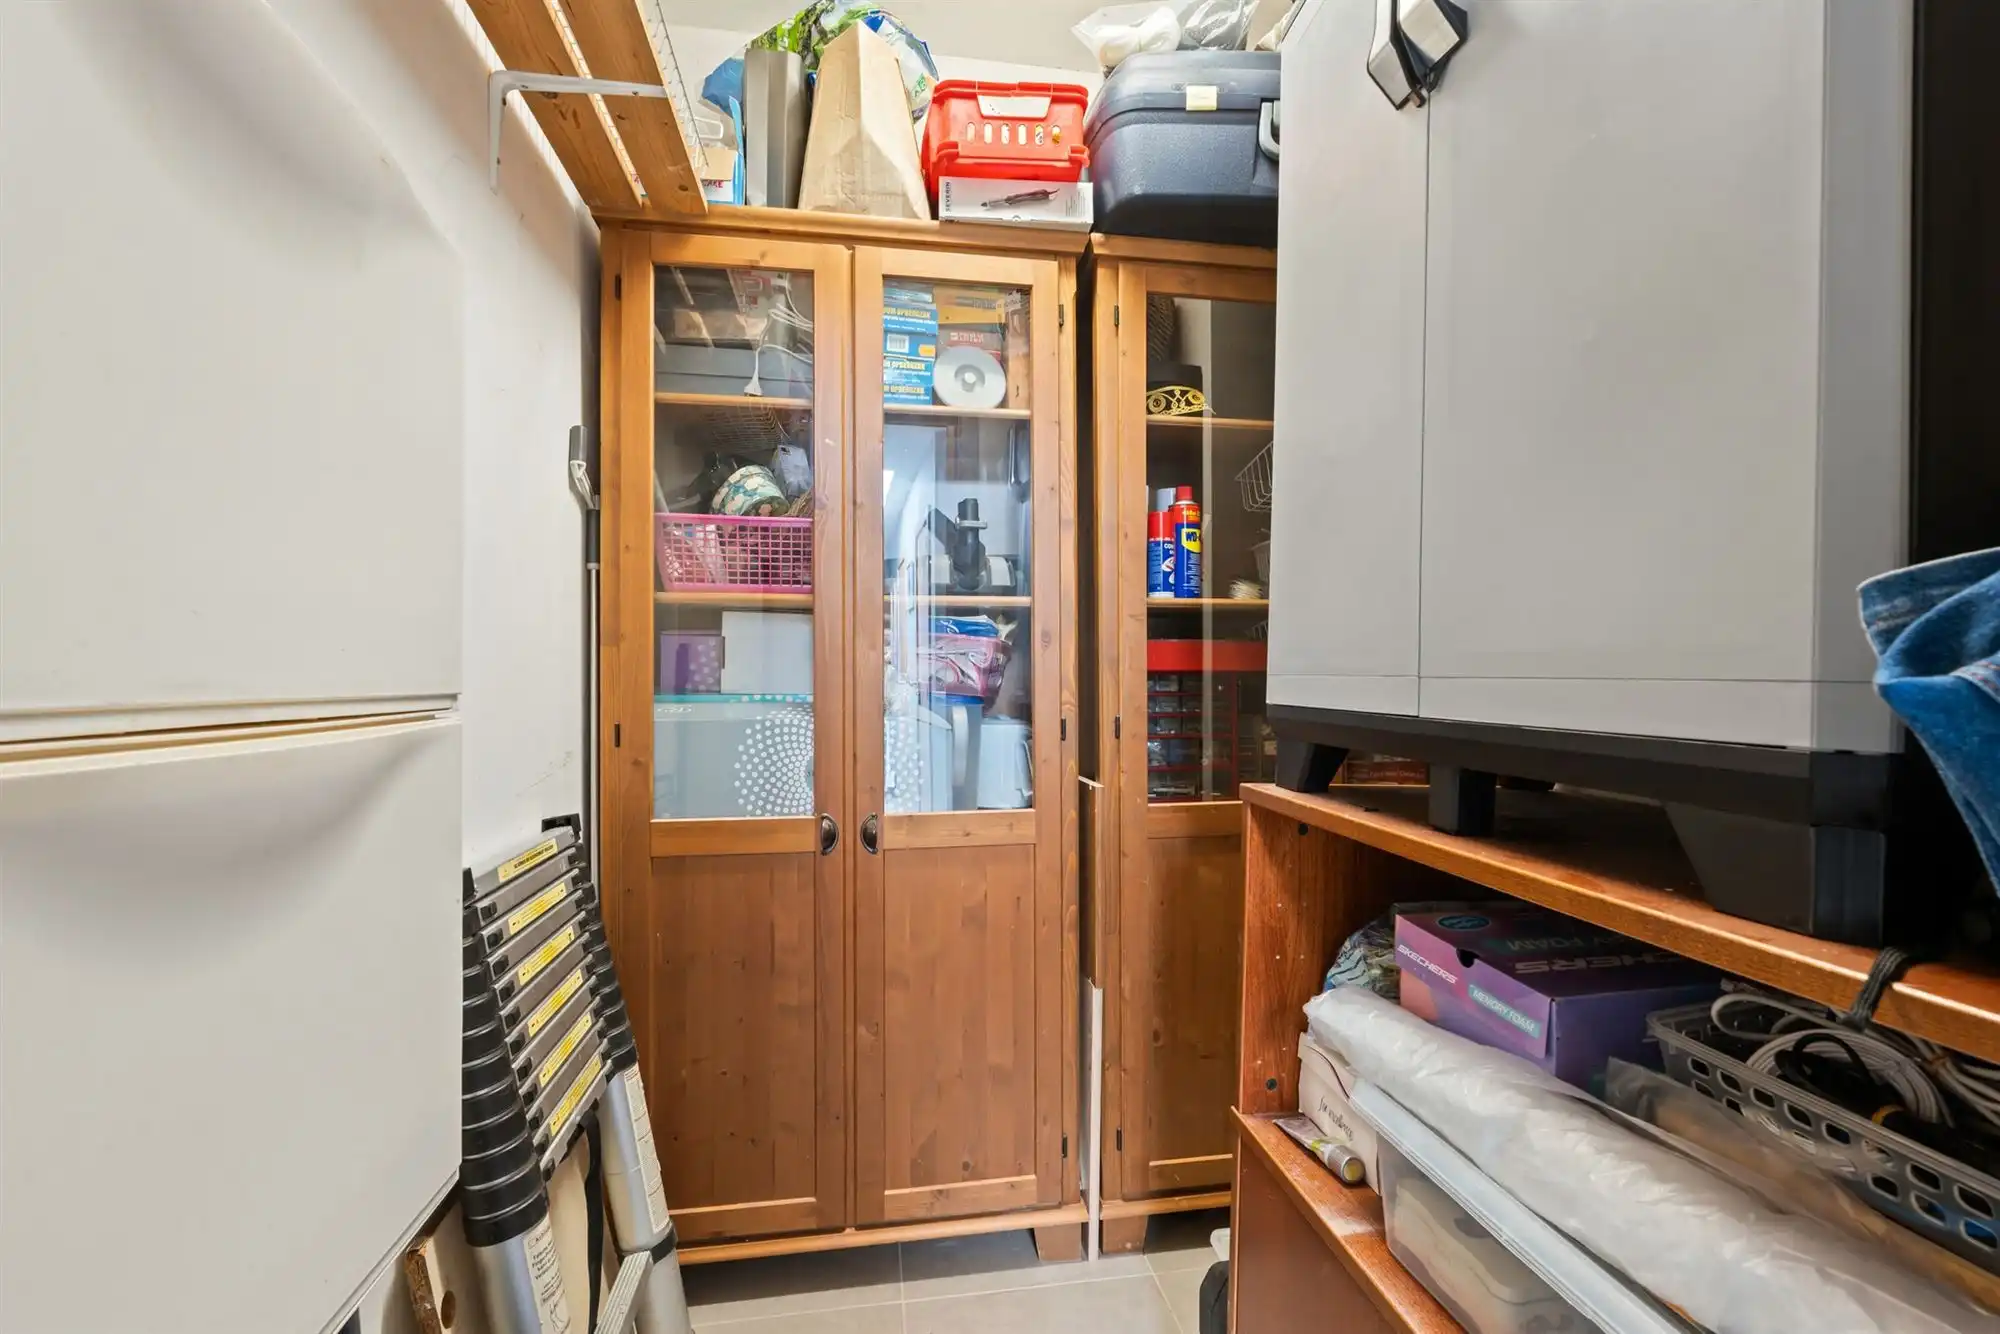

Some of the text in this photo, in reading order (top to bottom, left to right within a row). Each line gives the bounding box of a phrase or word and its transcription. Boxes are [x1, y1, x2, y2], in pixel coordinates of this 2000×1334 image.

[1397, 944, 1458, 984] SKECHERS
[1472, 990, 1535, 1033] MEMORY FOAM
